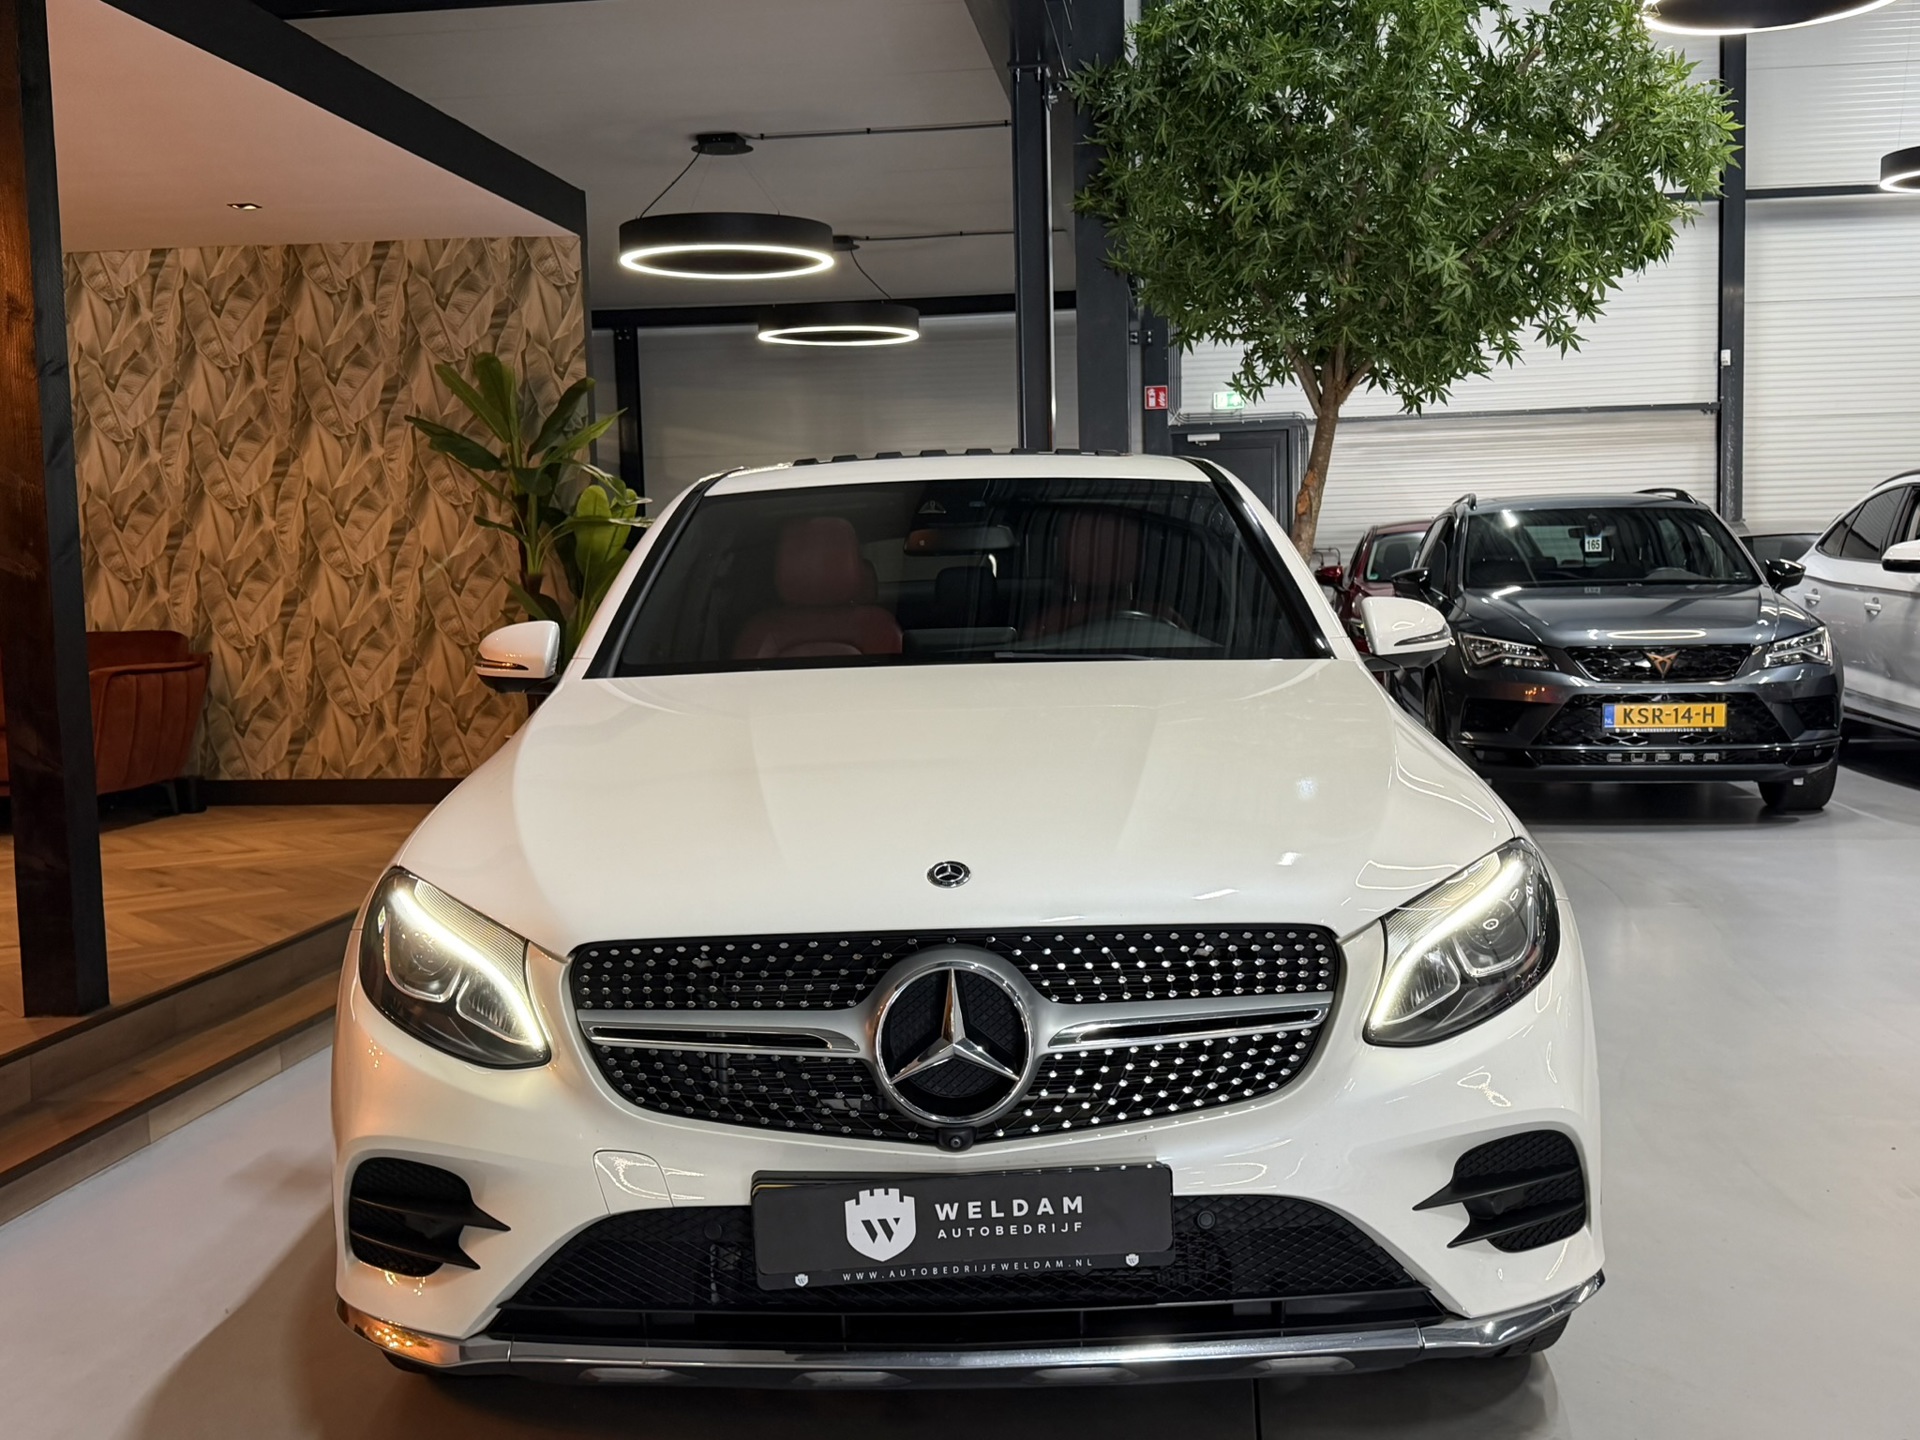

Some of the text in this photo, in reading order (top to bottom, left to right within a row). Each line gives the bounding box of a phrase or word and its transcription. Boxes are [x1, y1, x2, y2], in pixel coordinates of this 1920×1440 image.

[1587, 539, 1600, 550] 165
[1623, 706, 1716, 725] KSR-14-H
[1606, 753, 1720, 763] CUPRA
[934, 1196, 1083, 1221] WELDAM
[937, 1222, 1083, 1240] AUTOBEDRIJF
[842, 1258, 1093, 1281] WWW.AUTOBEDRIJFWELDAM.NL
